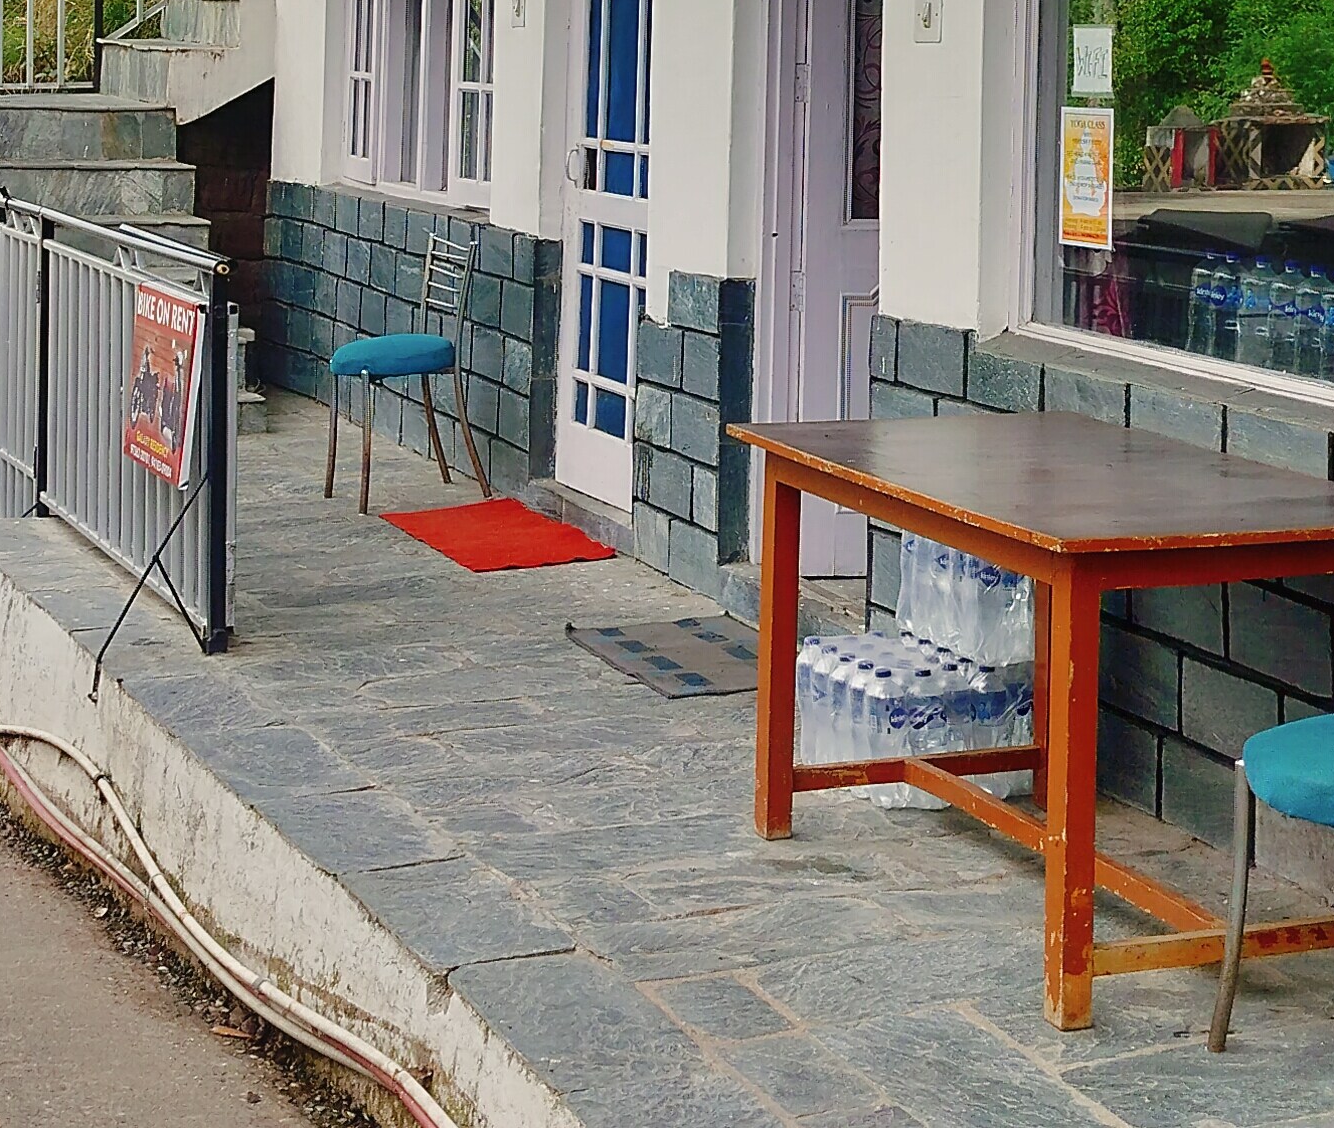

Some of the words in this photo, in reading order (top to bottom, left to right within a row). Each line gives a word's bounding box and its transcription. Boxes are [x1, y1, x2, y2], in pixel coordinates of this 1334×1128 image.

[1088, 120, 1105, 130] CLASS
[137, 291, 156, 321] BIKE
[156, 298, 170, 327] ON
[171, 305, 195, 336] RENT
